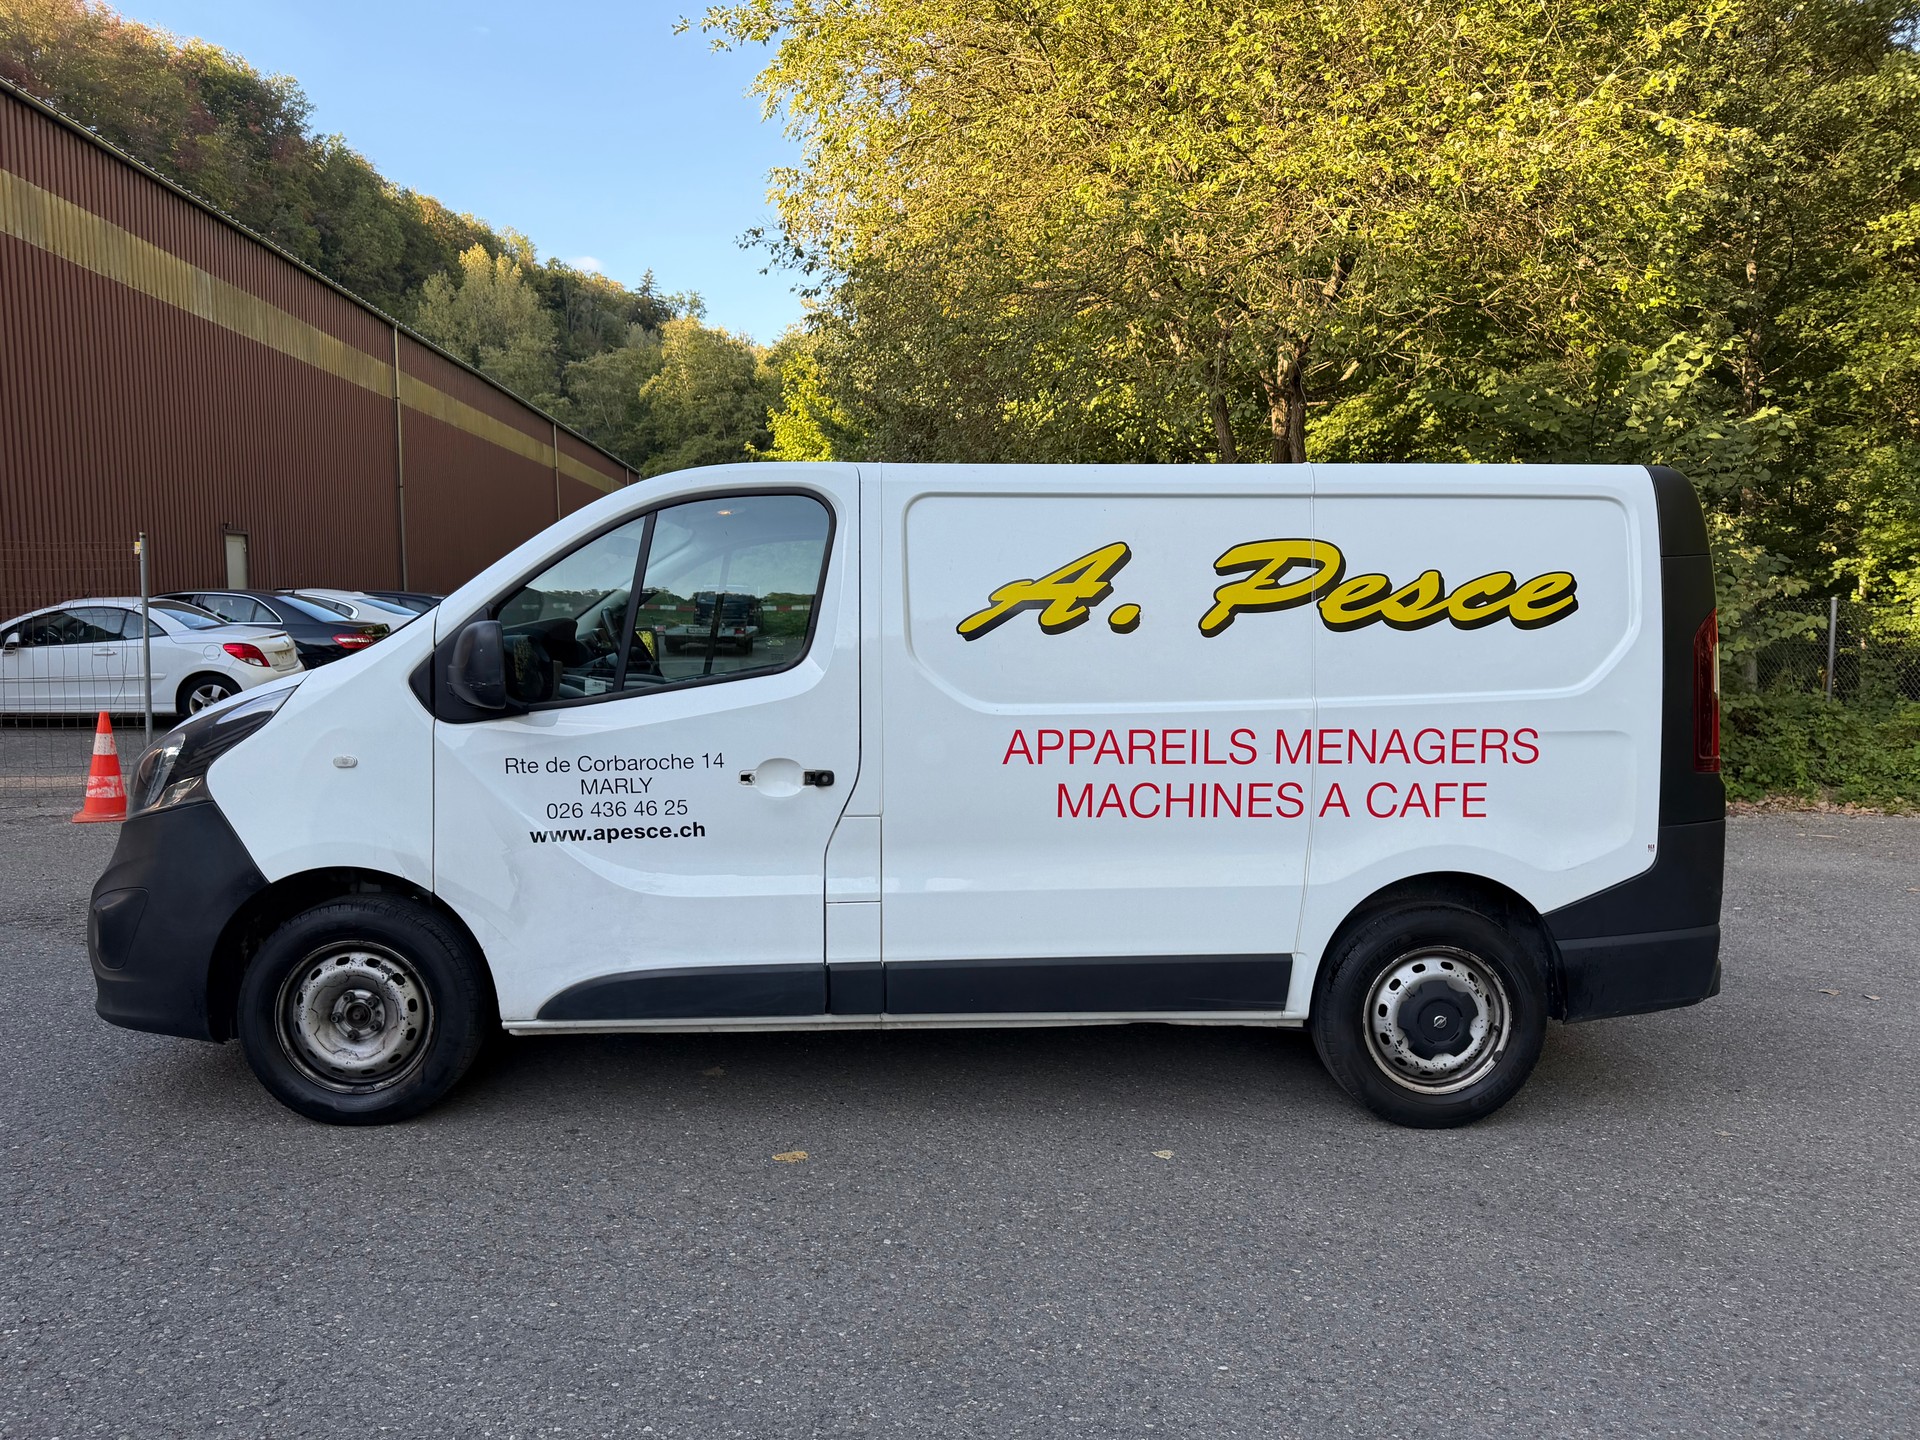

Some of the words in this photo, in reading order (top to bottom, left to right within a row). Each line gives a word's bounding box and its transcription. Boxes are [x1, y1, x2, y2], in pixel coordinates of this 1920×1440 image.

[956, 541, 1141, 641] A.
[1198, 538, 1578, 638] Pesce
[1002, 728, 1257, 765] APPAREILS
[1275, 728, 1540, 765] MENAGERS
[504, 757, 539, 774] Rte
[545, 756, 571, 773] de
[577, 753, 695, 772] Corbaroche
[701, 752, 725, 768] 14
[580, 777, 653, 795] MARLY
[546, 803, 584, 819] 026
[590, 801, 627, 817] 436
[633, 800, 658, 816] 46
[664, 799, 688, 815] 25
[1057, 782, 1304, 818] MACHINES
[1319, 782, 1351, 818] A
[1366, 781, 1487, 819] CAFE
[530, 821, 706, 843] www.apesce.ch
